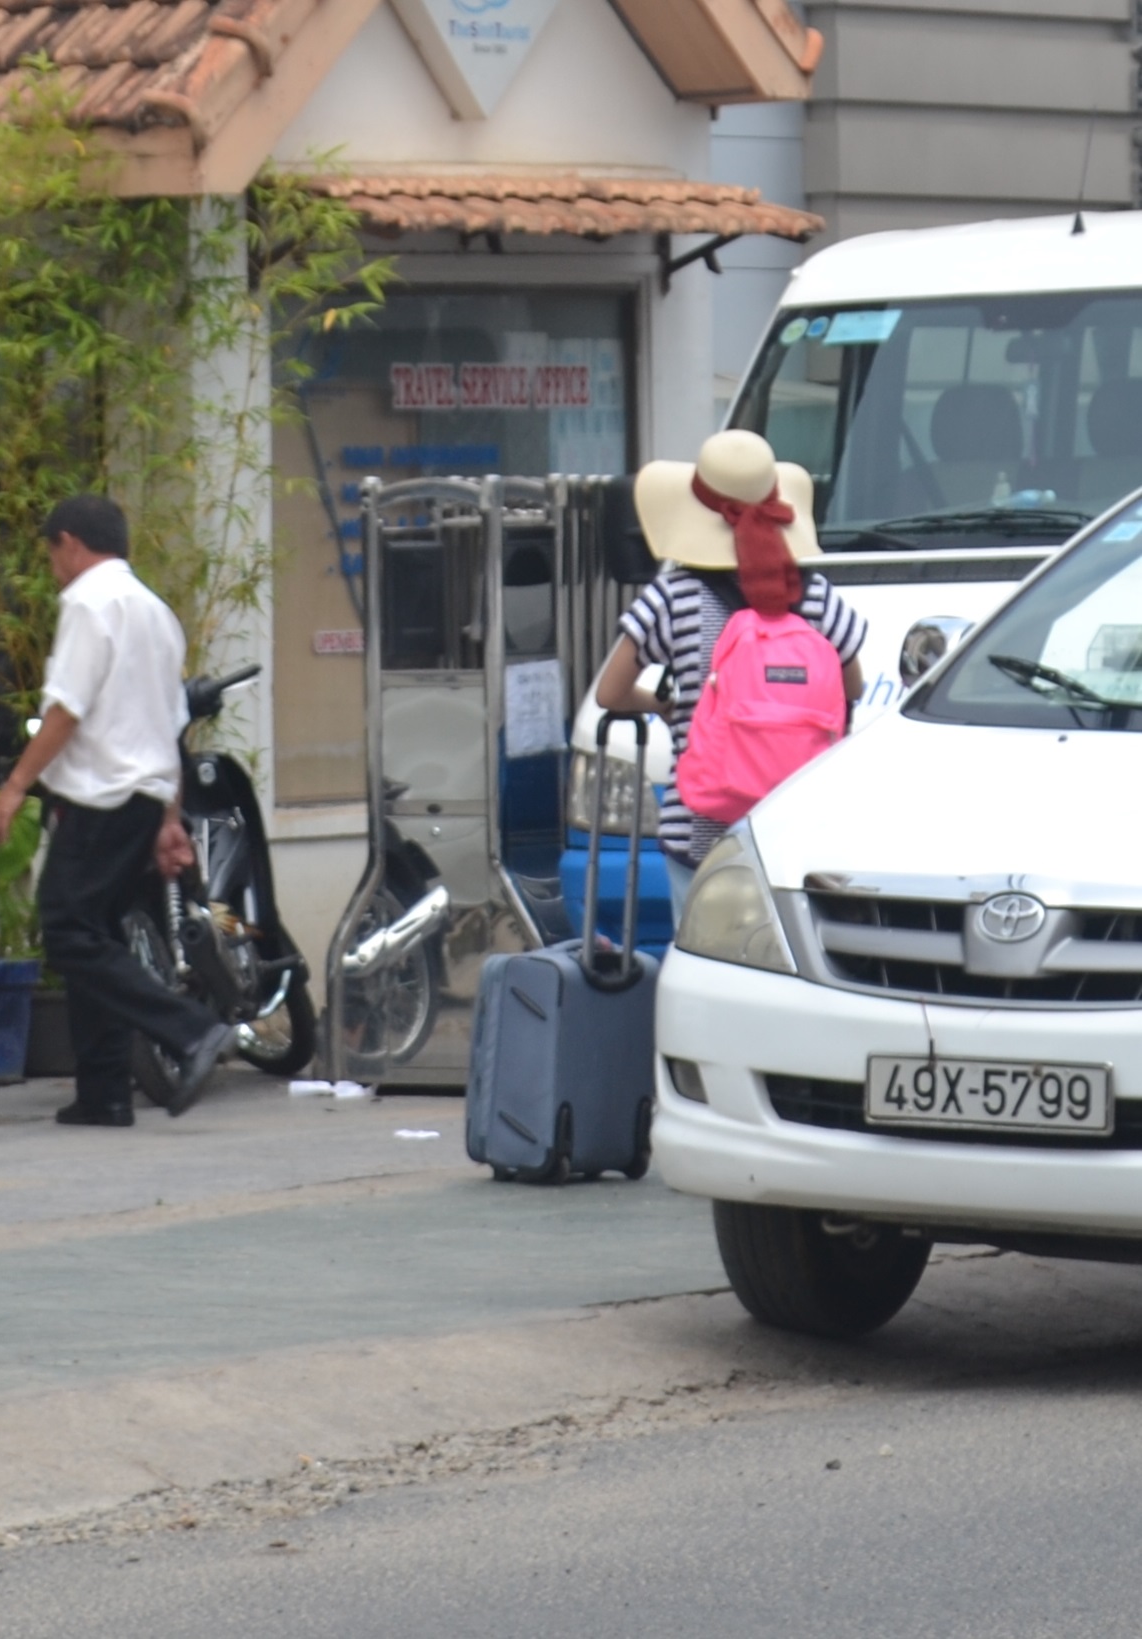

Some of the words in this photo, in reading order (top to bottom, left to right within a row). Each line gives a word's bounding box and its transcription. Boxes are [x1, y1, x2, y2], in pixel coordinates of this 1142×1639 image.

[392, 365, 454, 406] TRAVEL
[461, 365, 528, 406] SERVICE
[535, 365, 590, 406] OFFICE
[884, 1064, 1091, 1121] 49X-5799
